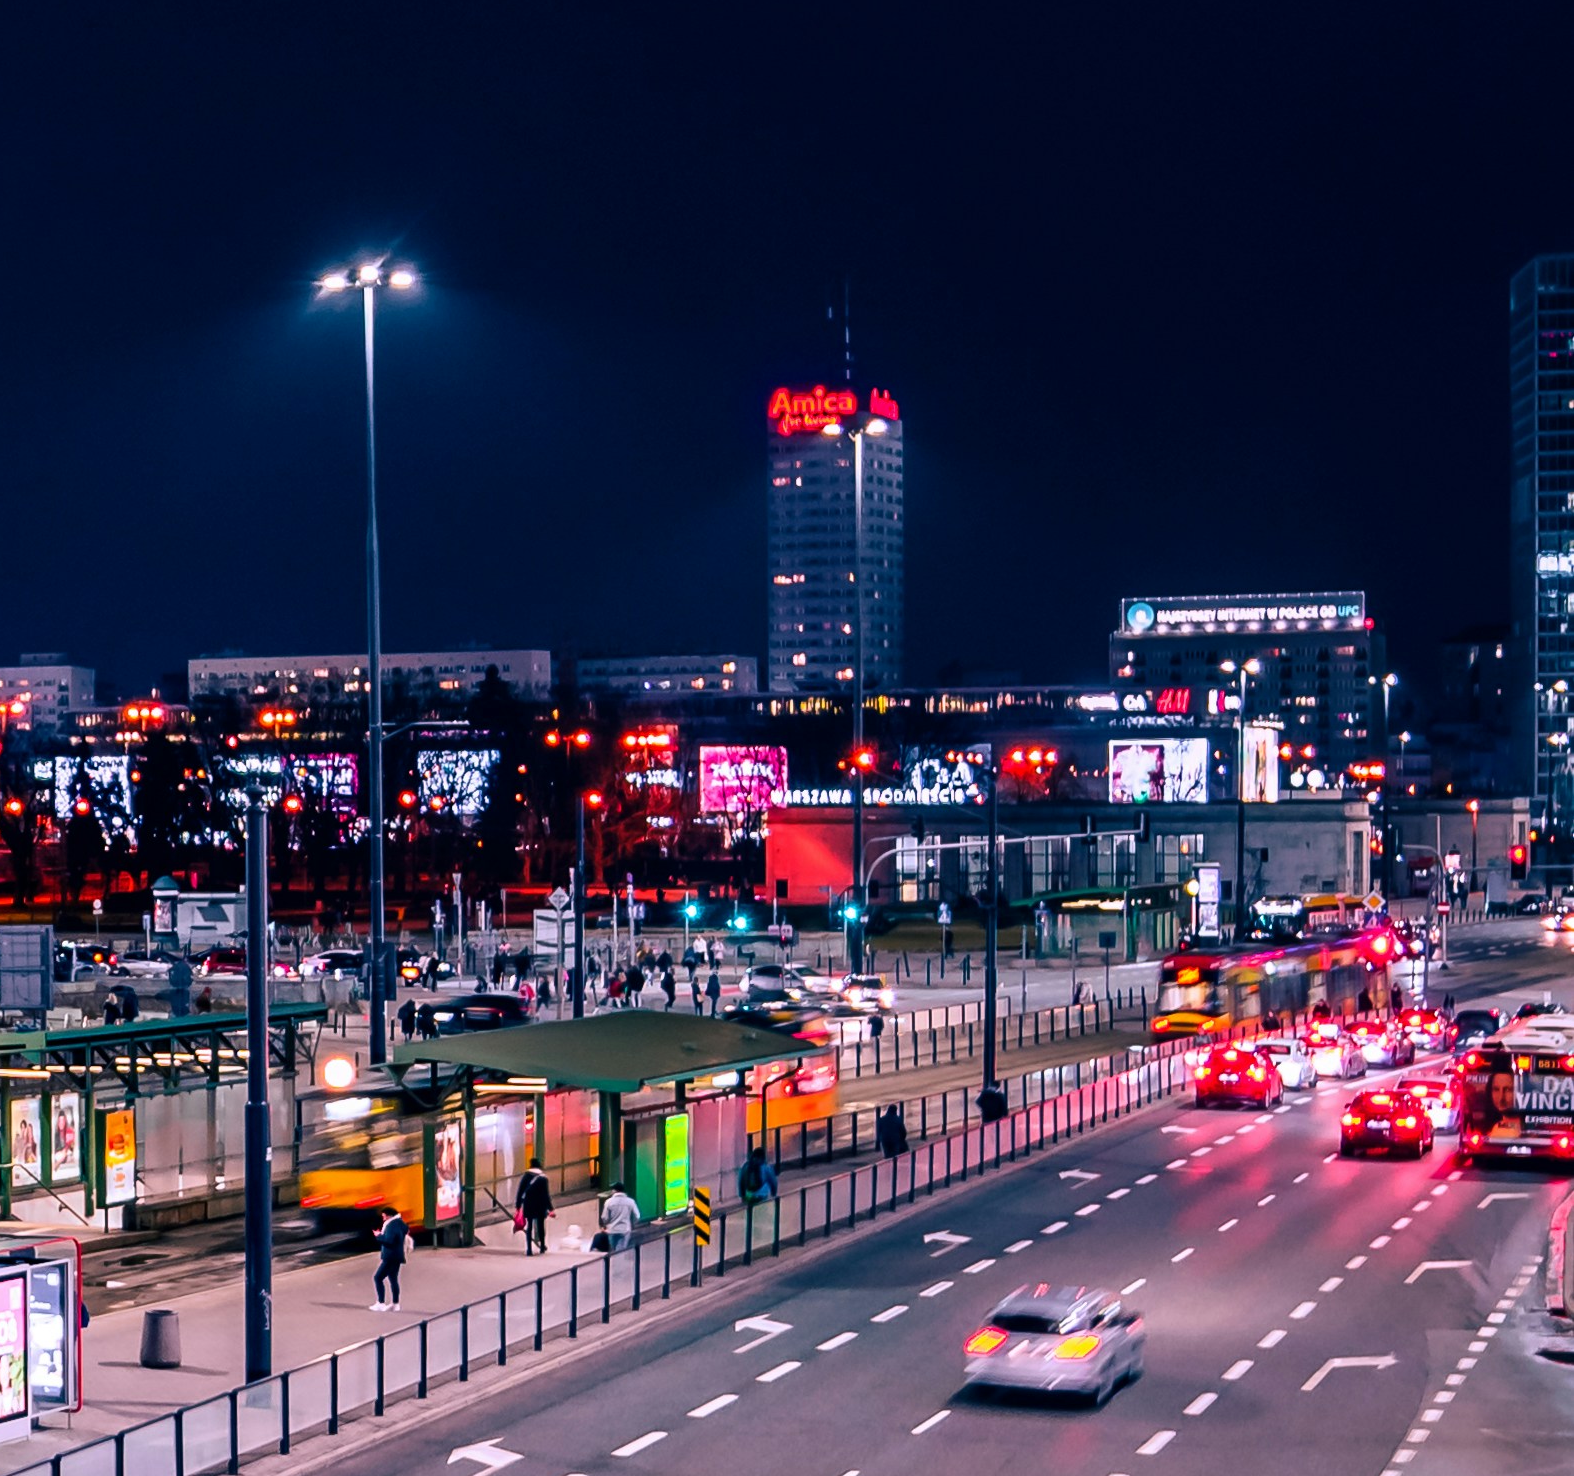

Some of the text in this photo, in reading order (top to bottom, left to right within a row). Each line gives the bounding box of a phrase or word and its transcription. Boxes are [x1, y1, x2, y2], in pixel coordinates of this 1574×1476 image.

[770, 387, 855, 416] Amica
[1337, 604, 1360, 618] UPC
[770, 788, 851, 805] WARSZAWA
[1543, 1075, 1574, 1093] DA
[1525, 1115, 1572, 1124] EXHIBITION
